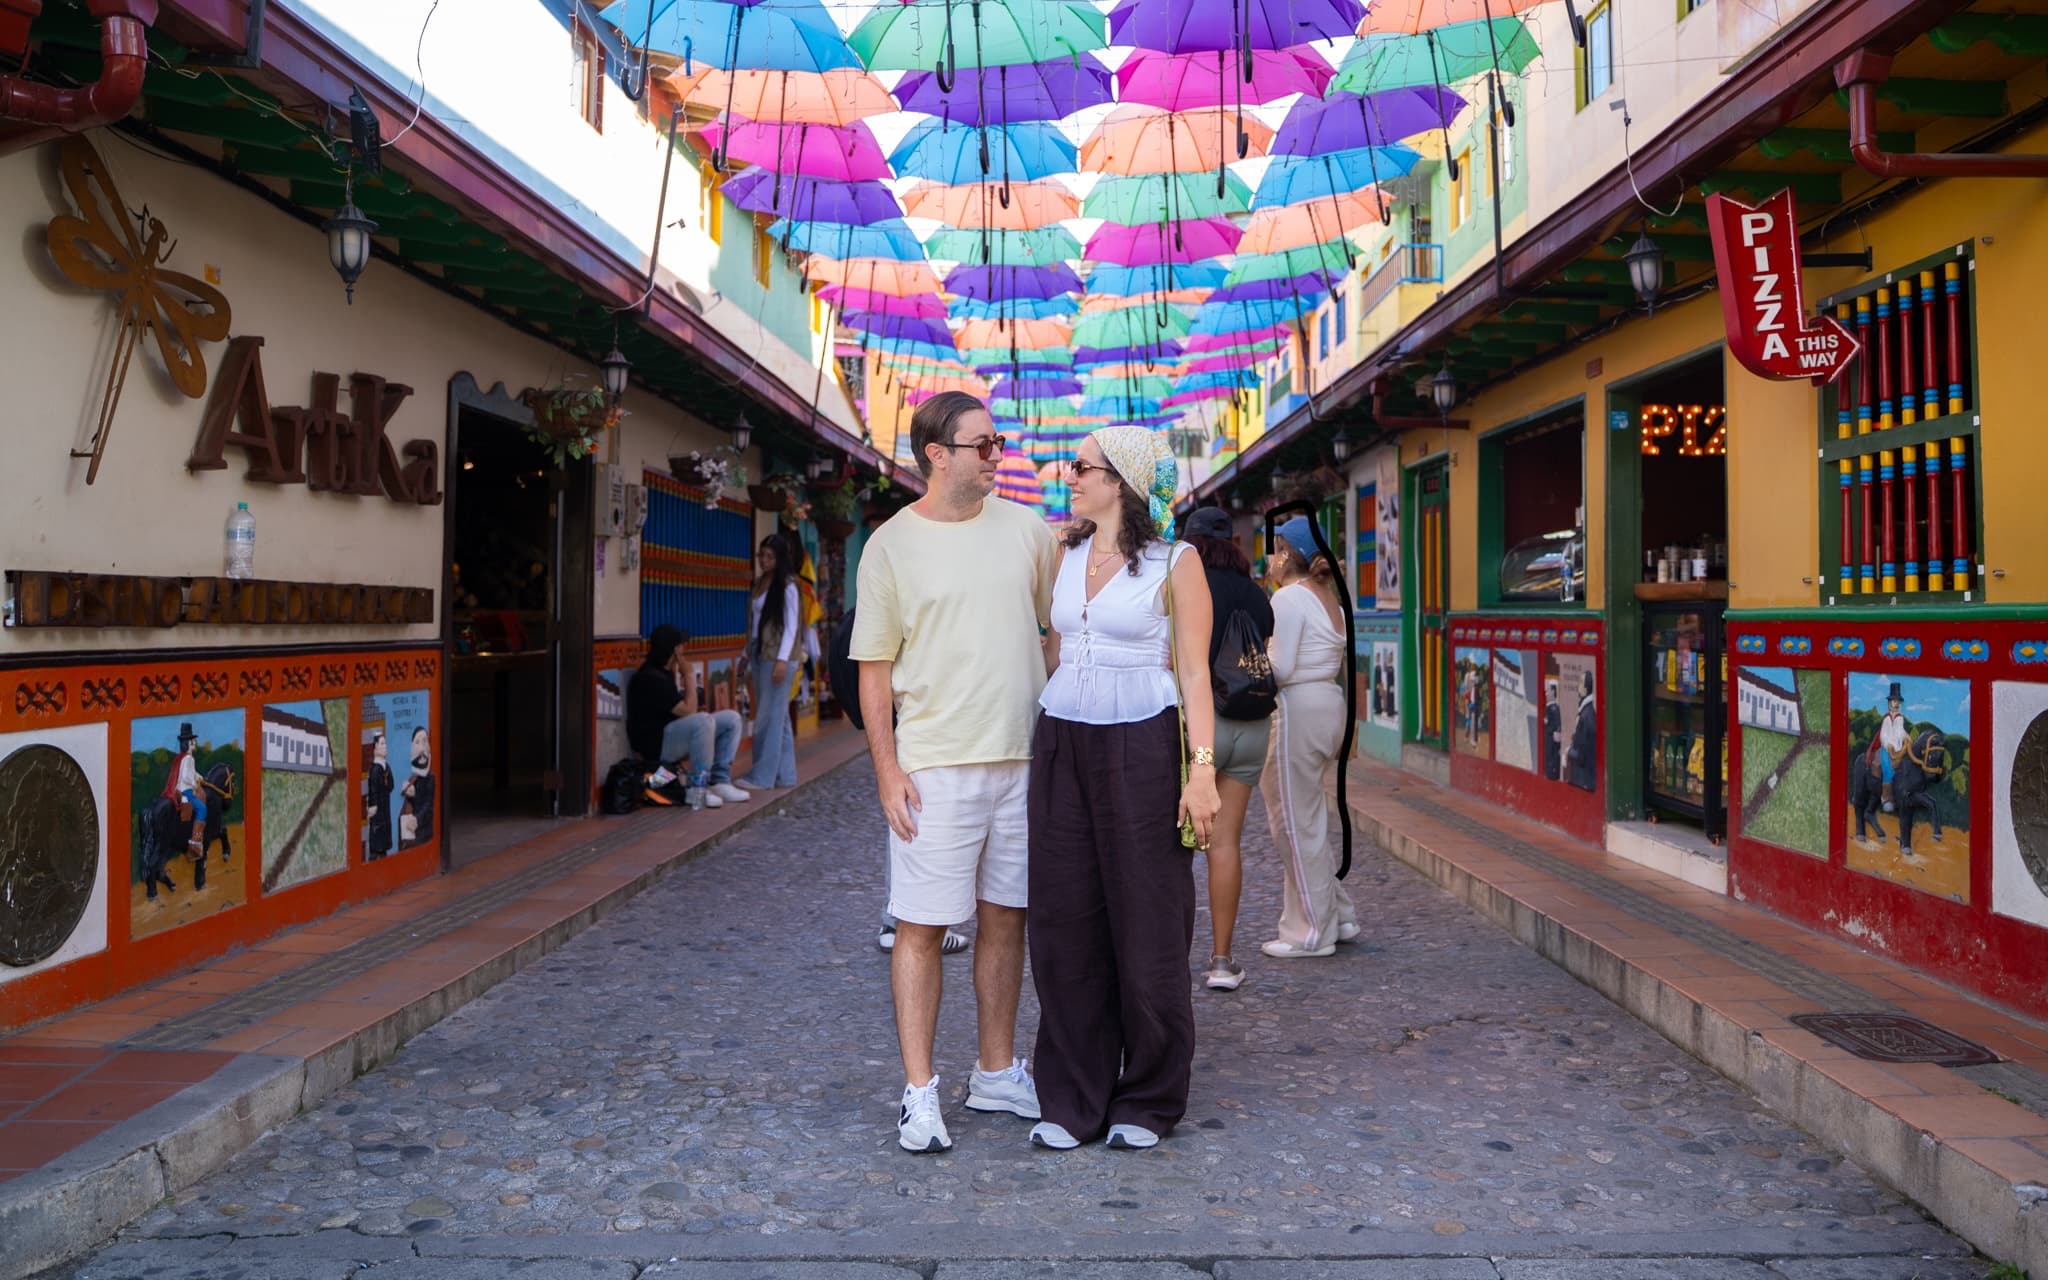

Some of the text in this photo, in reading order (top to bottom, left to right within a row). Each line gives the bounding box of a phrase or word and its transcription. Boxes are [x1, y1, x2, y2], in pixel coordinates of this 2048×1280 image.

[1741, 212, 1790, 361] PIZZA
[1795, 334, 1839, 351] THIS
[1799, 351, 1838, 369] WAY
